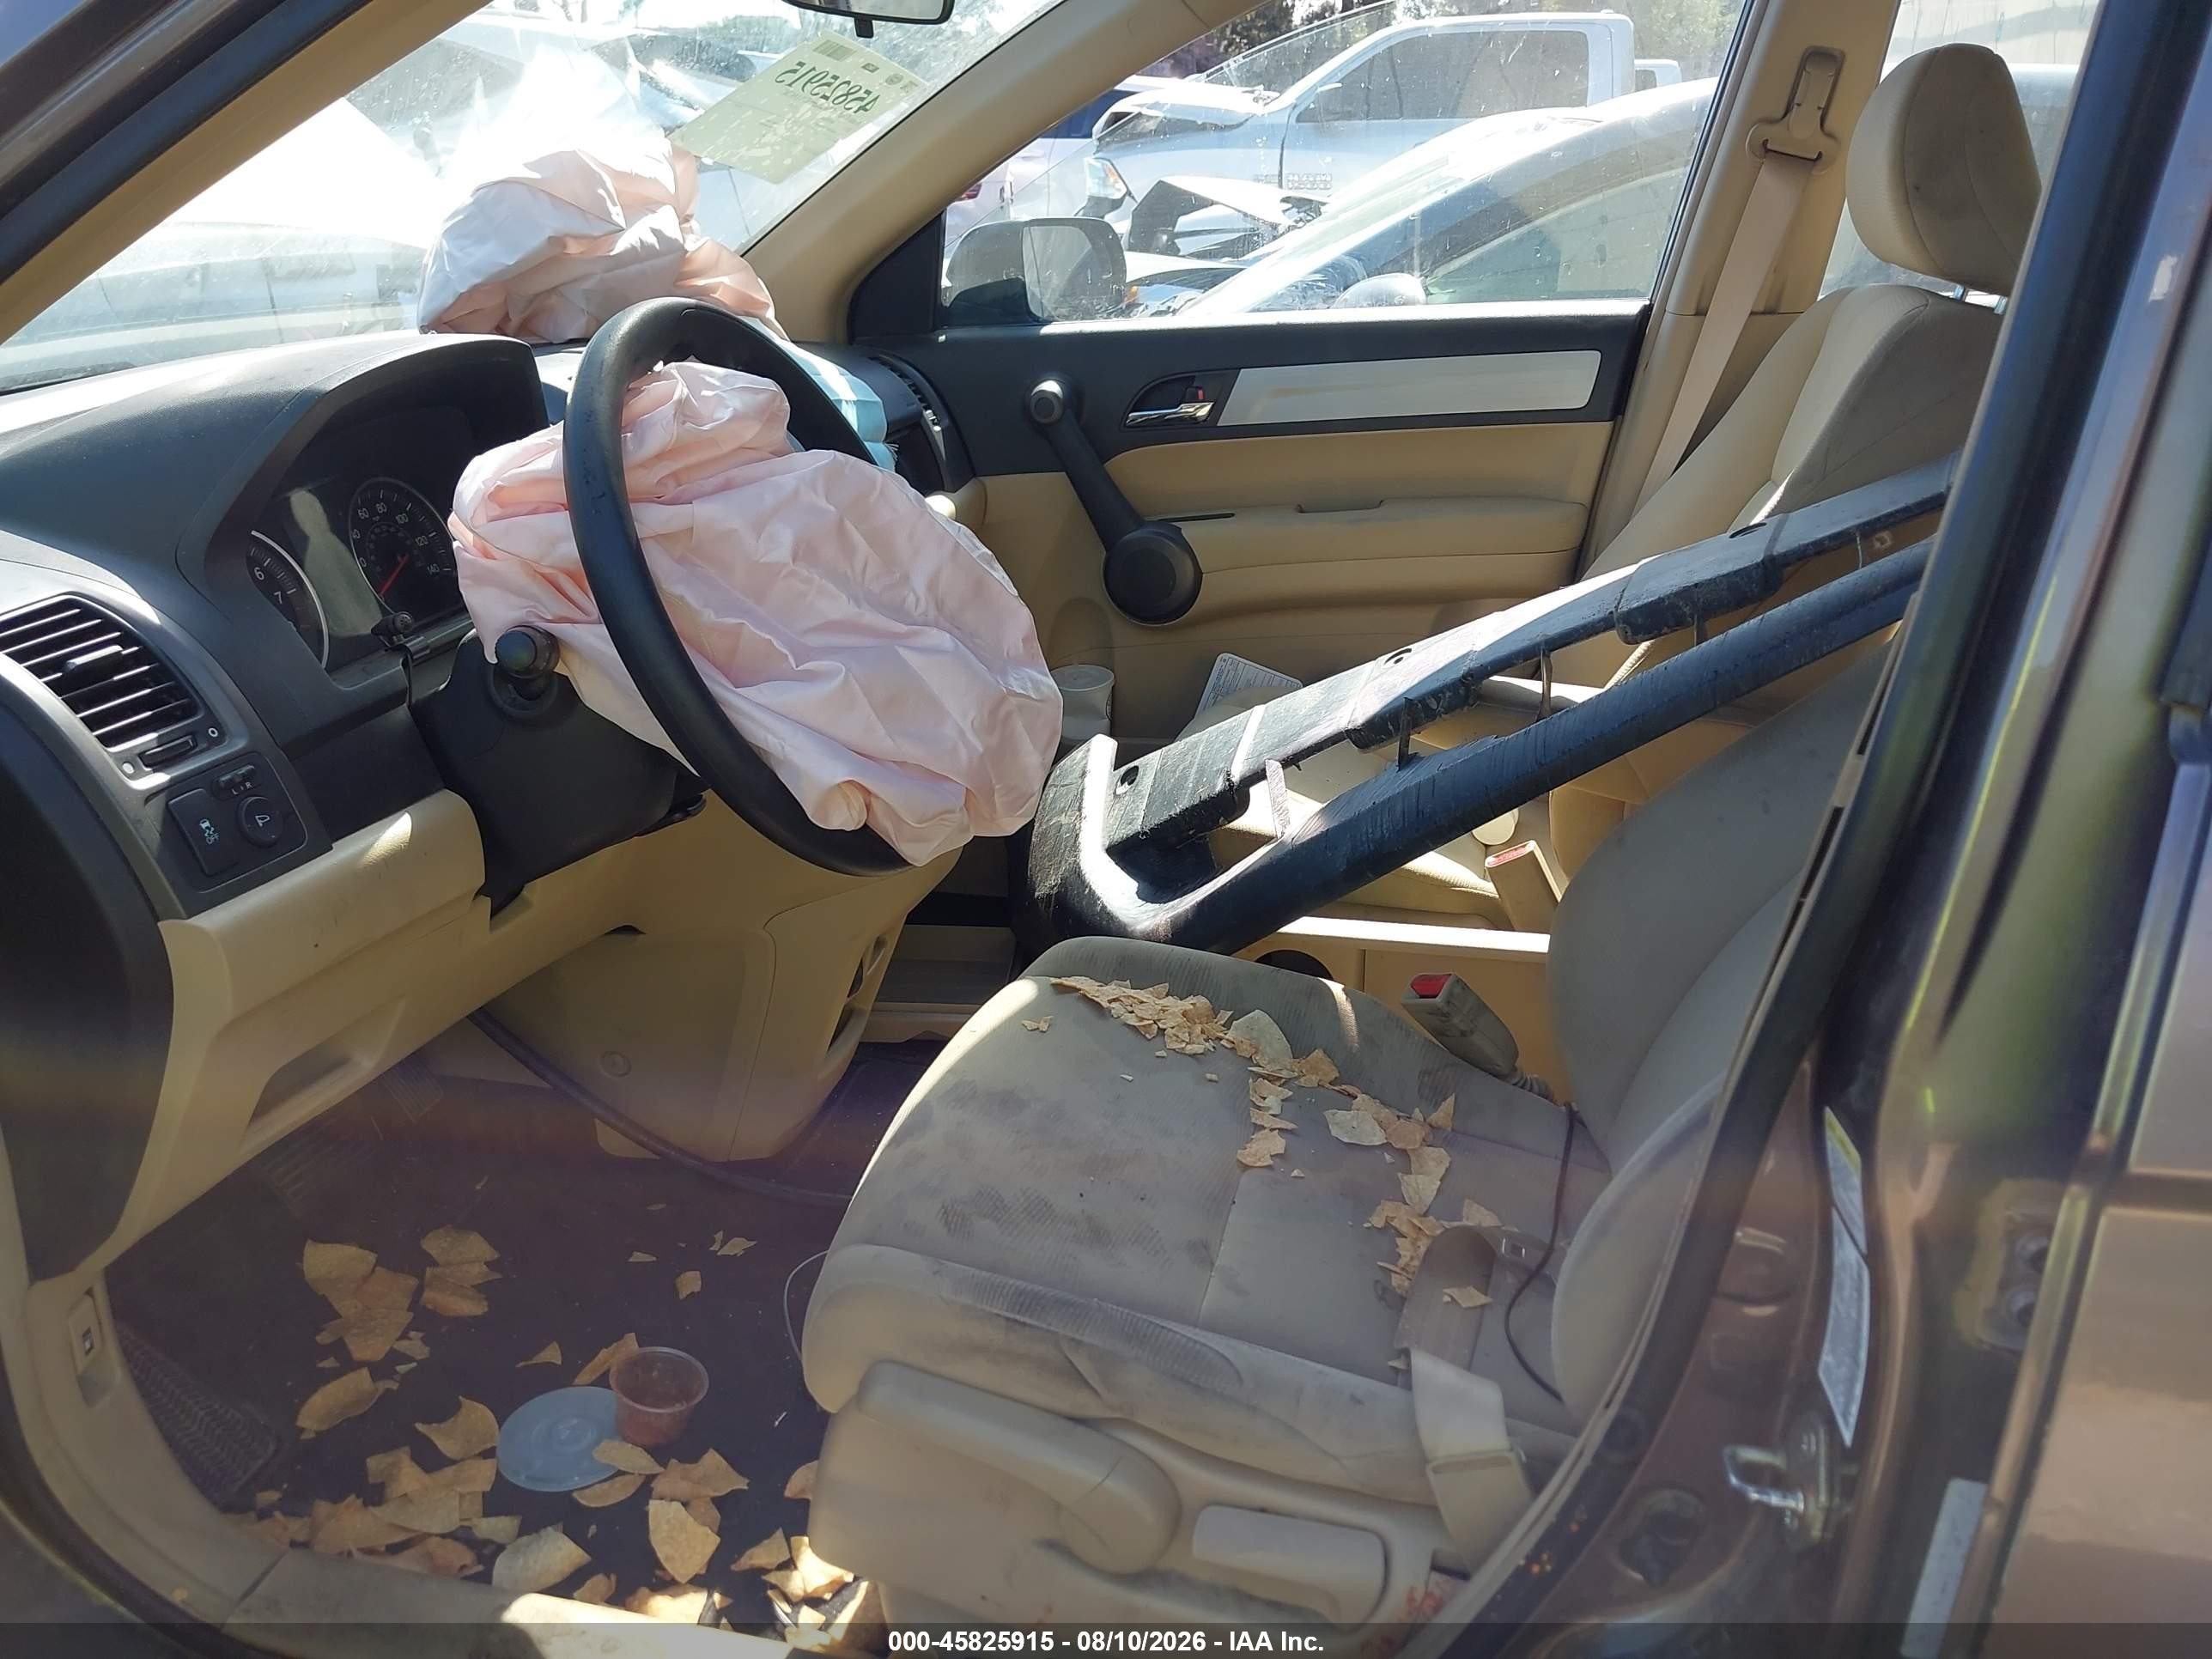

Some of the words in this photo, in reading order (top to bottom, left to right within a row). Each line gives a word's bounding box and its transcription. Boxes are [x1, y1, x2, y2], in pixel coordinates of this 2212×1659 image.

[415, 535, 429, 547] 120
[253, 566, 265, 580] 6
[273, 590, 283, 605] 7
